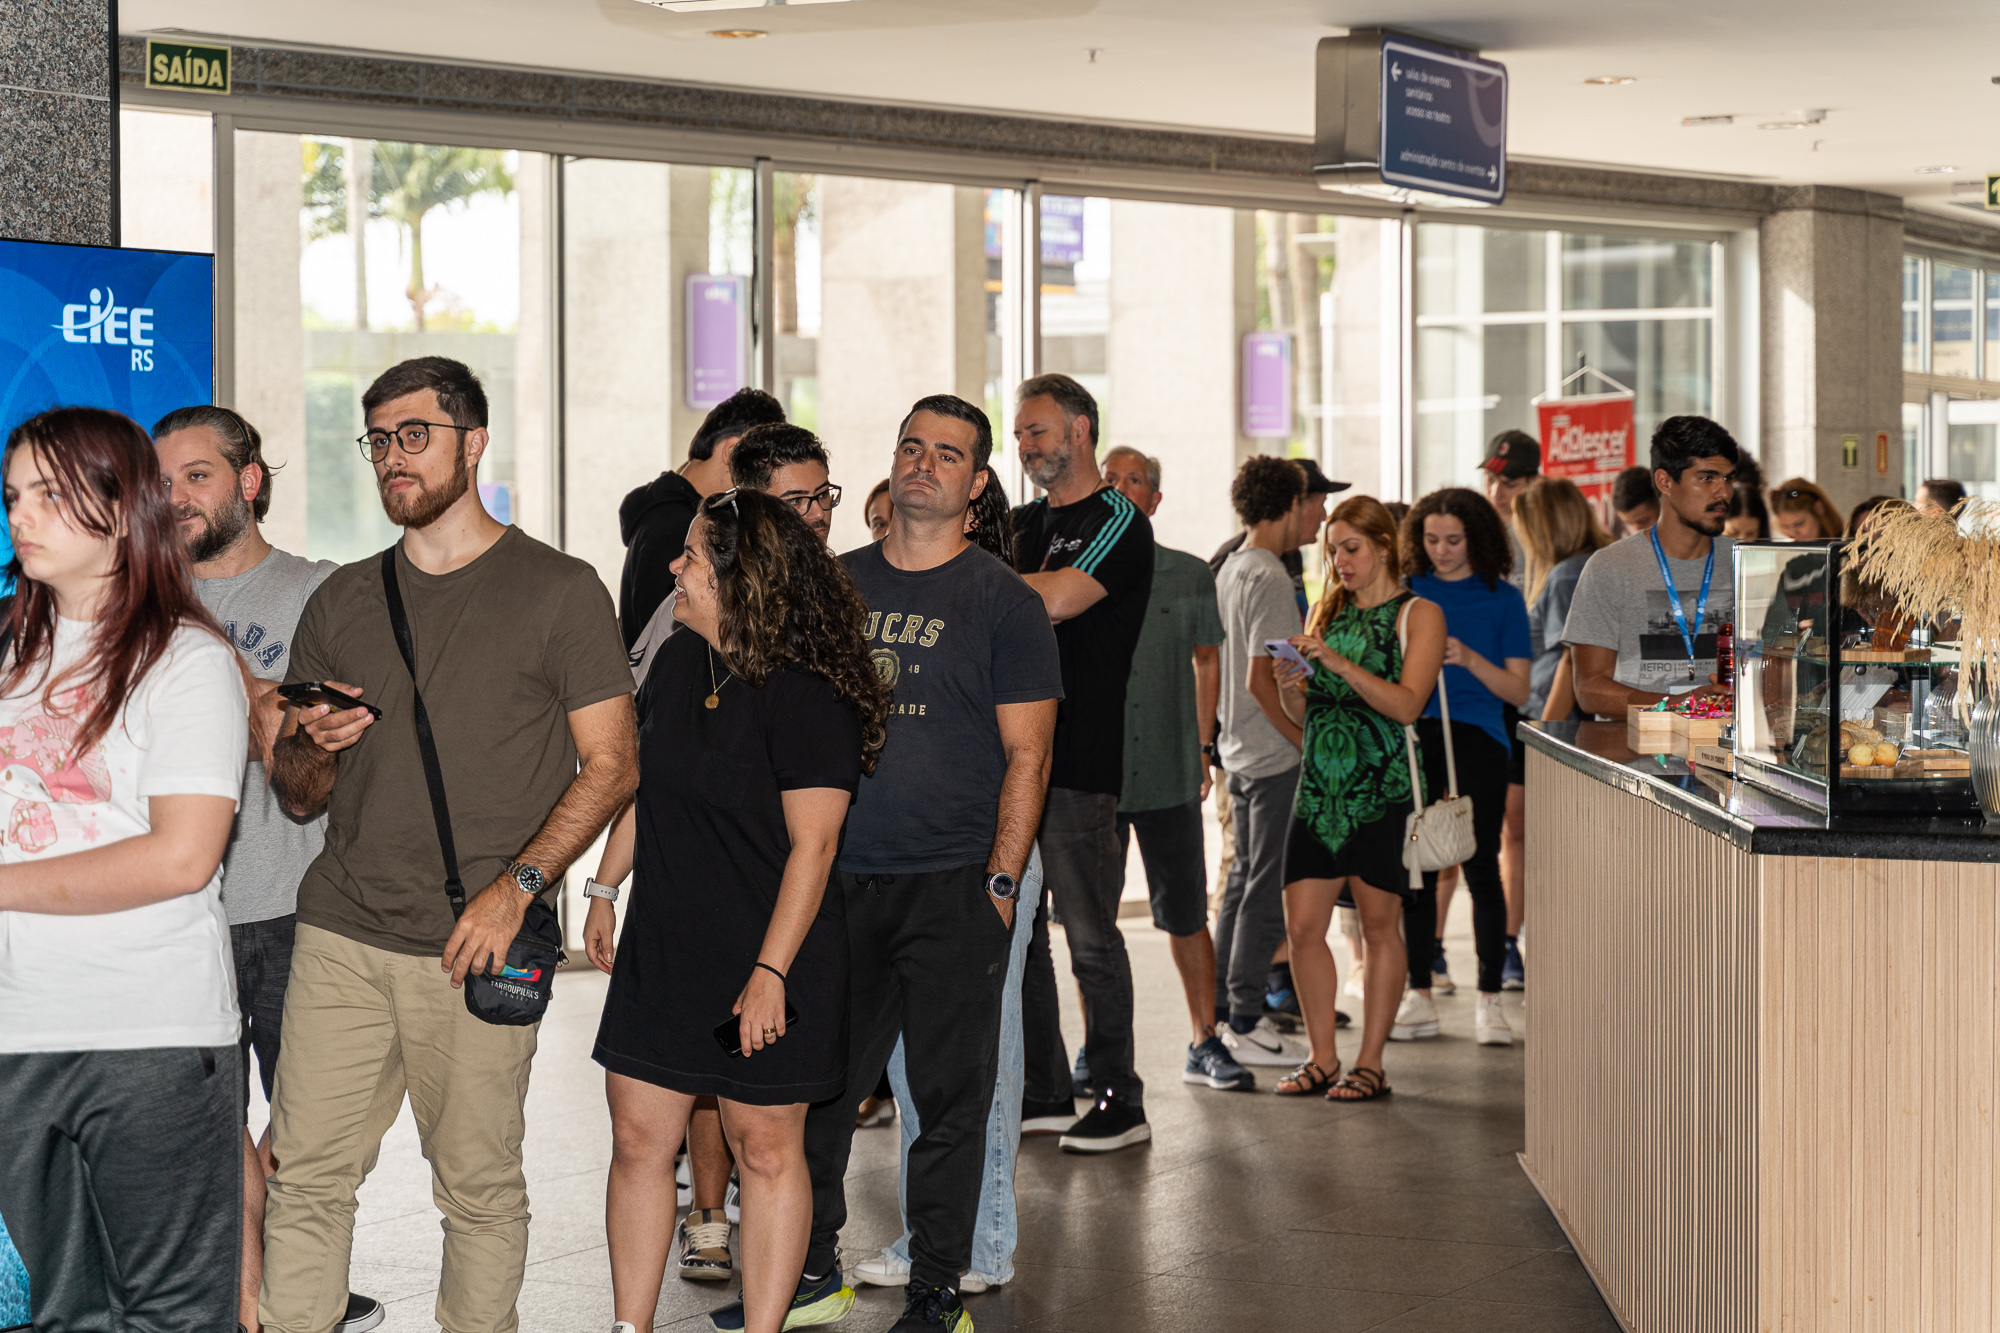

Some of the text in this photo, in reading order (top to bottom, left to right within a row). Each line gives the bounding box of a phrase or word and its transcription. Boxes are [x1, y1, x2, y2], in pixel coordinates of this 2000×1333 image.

[153, 48, 224, 87] SAÍDA
[1429, 74, 1452, 89] eventos
[131, 348, 154, 372] RS
[862, 612, 945, 648] UCRS
[223, 620, 287, 670] ADA
[908, 664, 920, 674] 48
[889, 704, 926, 716] DADE
